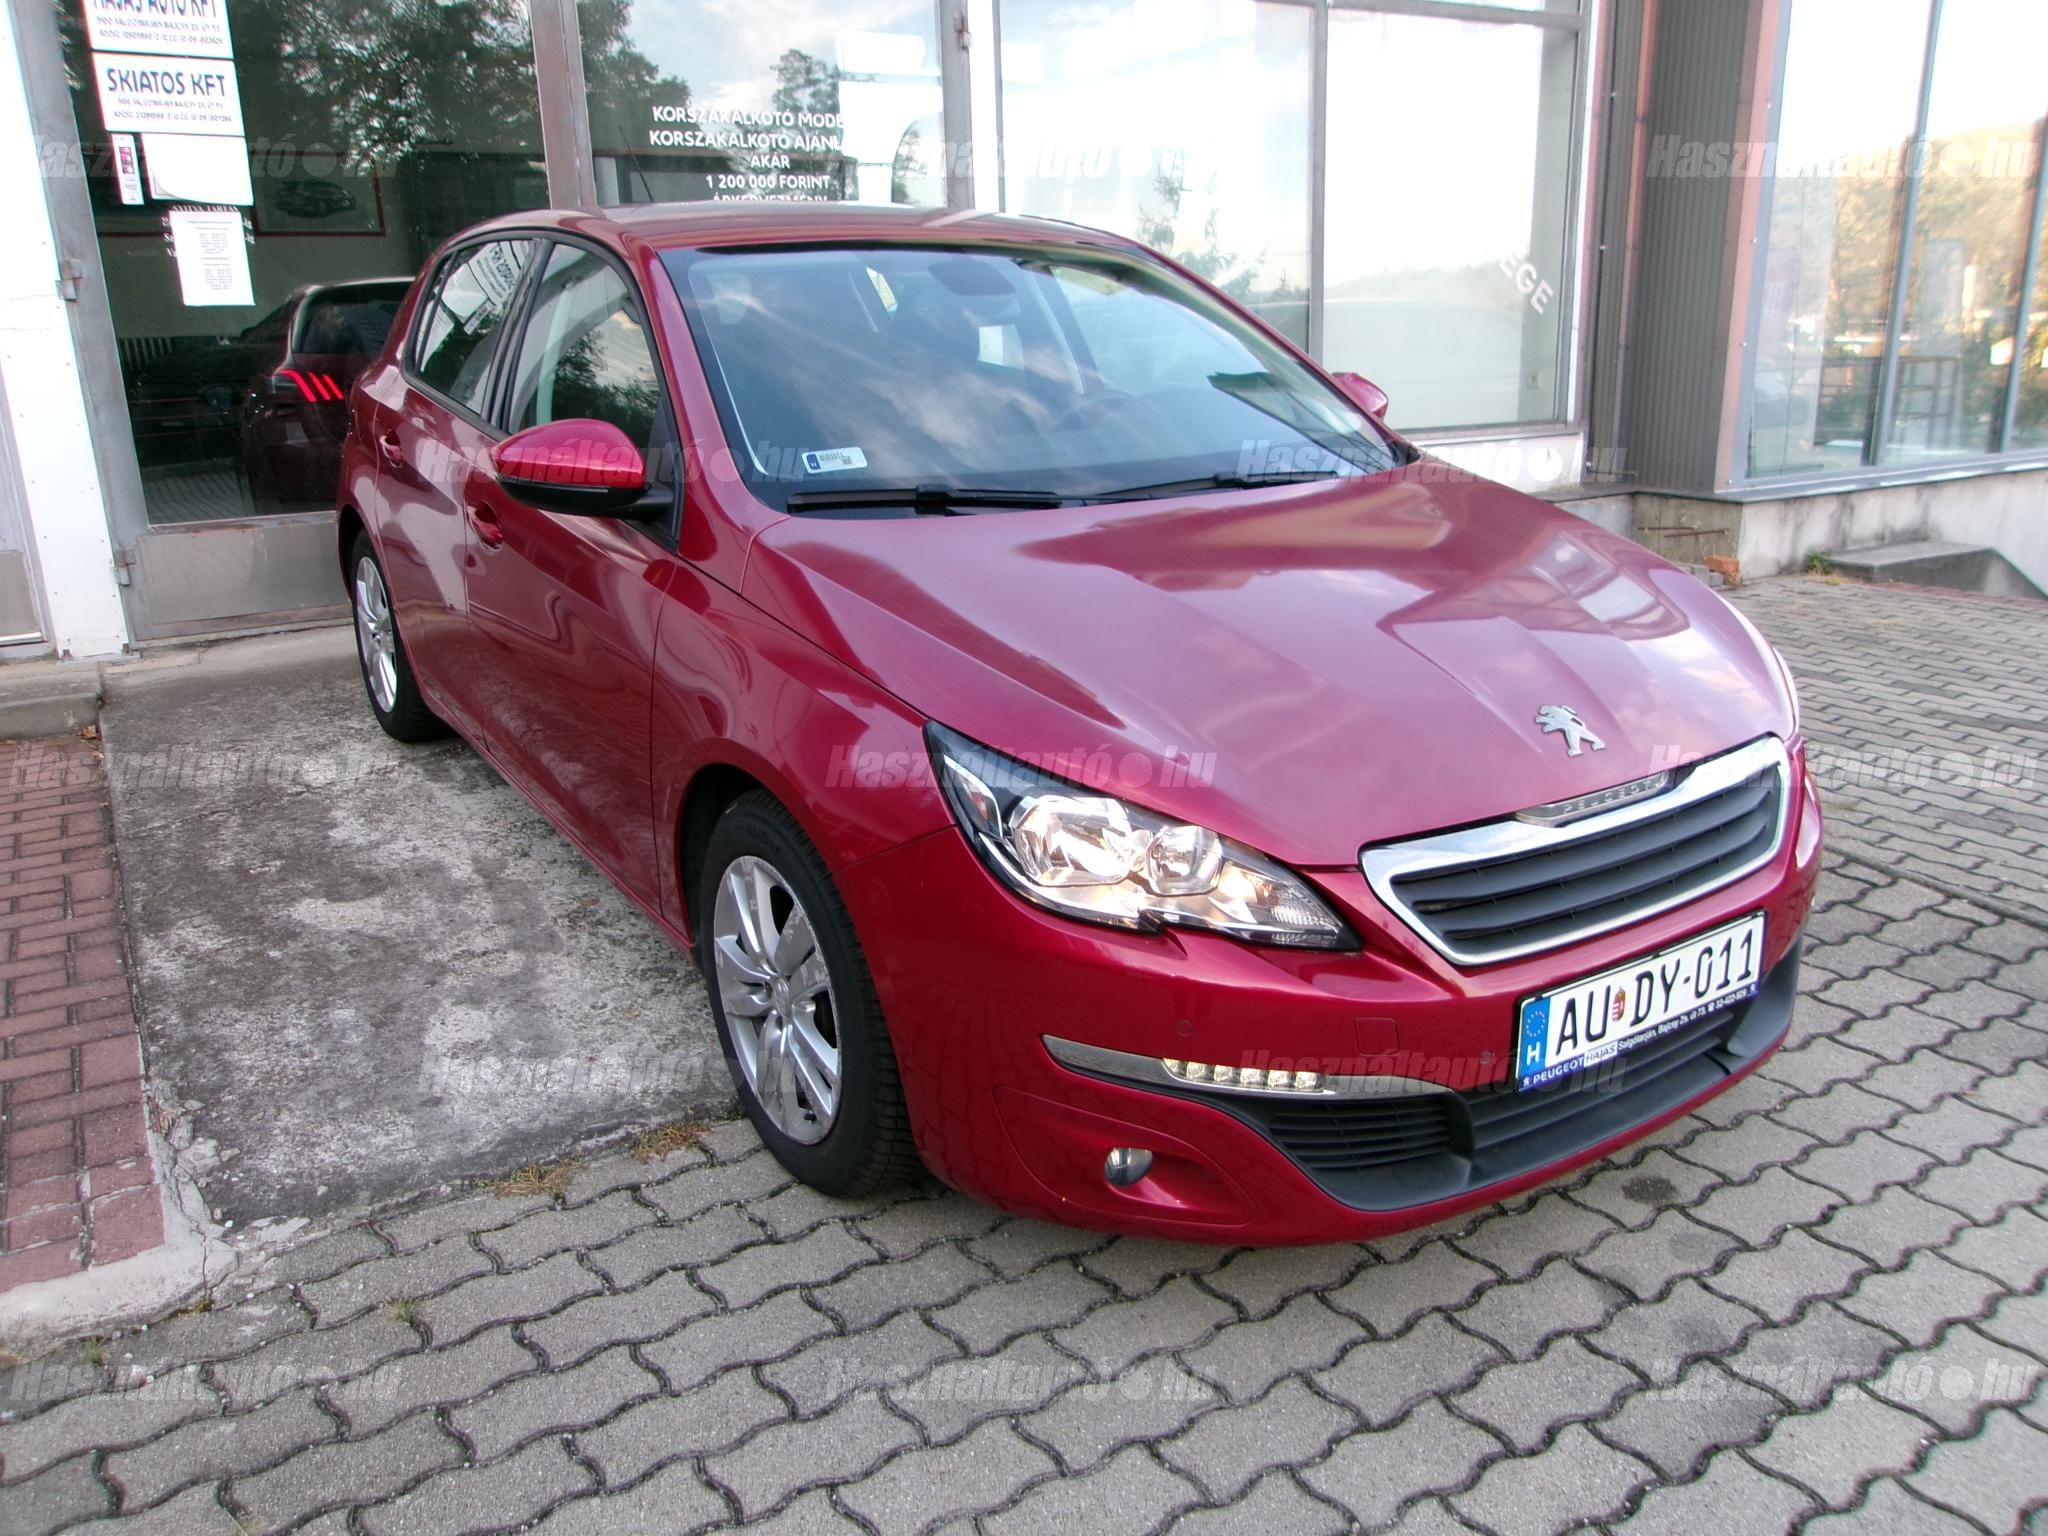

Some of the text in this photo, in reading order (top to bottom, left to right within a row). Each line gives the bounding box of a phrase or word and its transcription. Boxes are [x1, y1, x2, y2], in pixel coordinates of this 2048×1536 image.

[107, 67, 225, 97] SKIATOS KFT
[750, 152, 791, 169] AKÁR
[705, 175, 713, 189] 1
[718, 175, 745, 189] 200
[779, 175, 831, 190] FORINT
[1556, 929, 1753, 1056] AU DY-011
[1526, 1041, 1541, 1066] H
[1533, 1057, 1584, 1084] PEUGEOT
[1585, 1044, 1616, 1063] HAJAS
